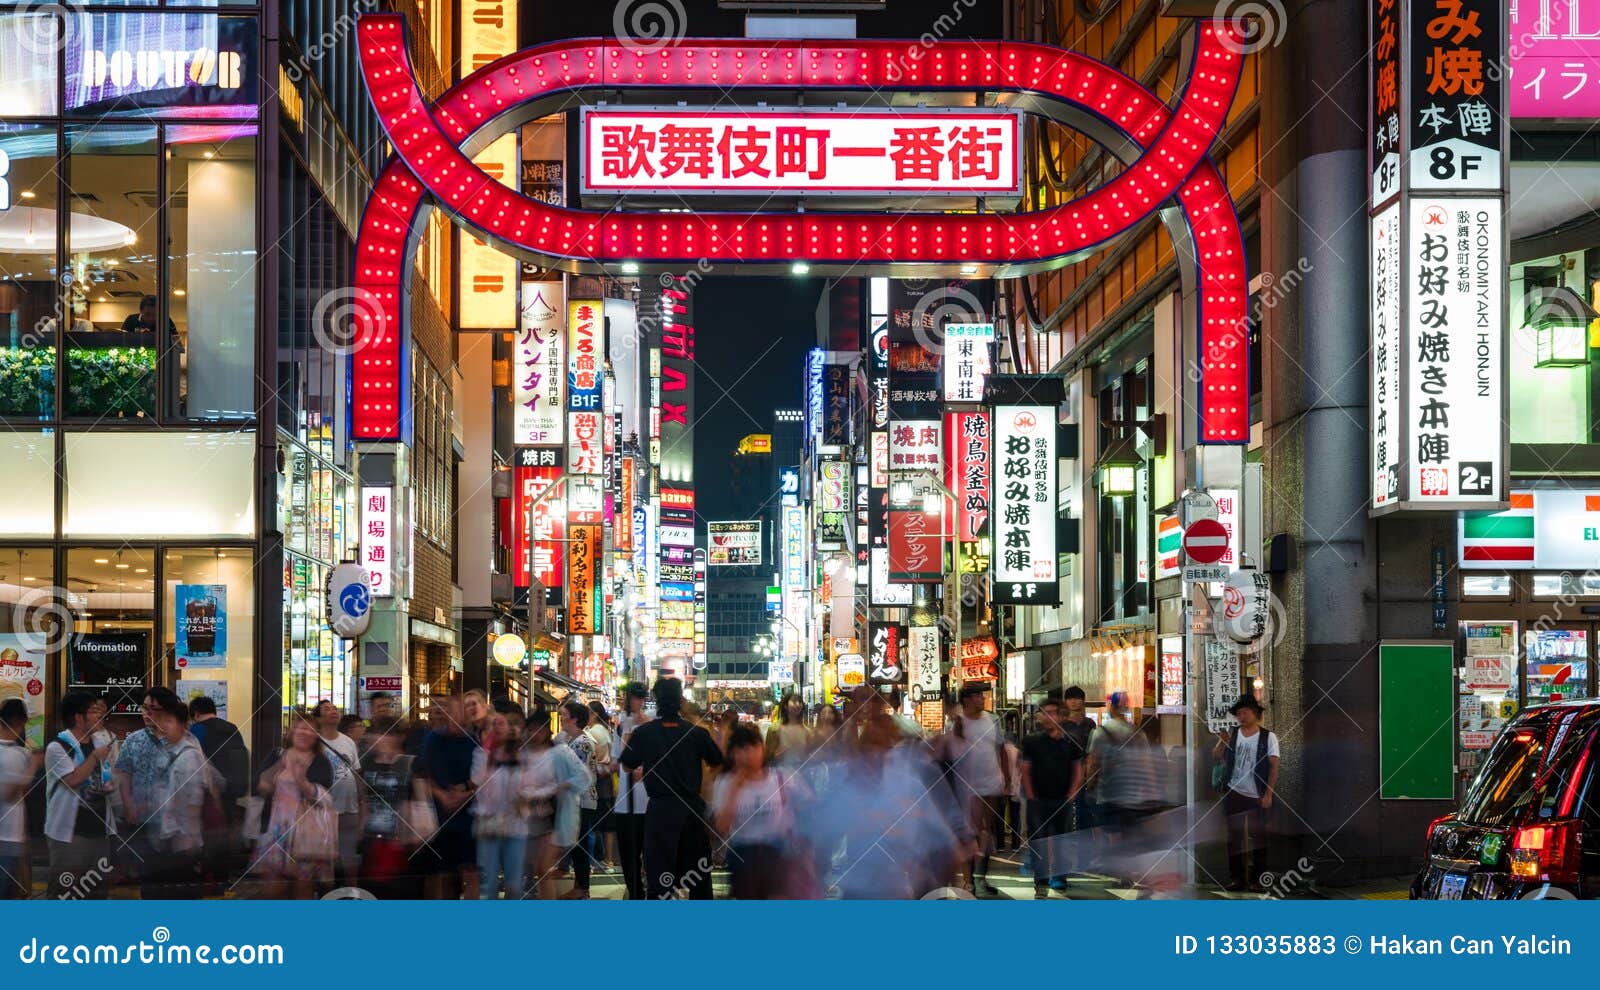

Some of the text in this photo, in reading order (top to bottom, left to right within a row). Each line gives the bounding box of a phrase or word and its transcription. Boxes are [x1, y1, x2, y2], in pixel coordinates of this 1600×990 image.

[84, 47, 241, 89] DOUTOR
[1419, 101, 1492, 137] 本陣
[602, 123, 1002, 182] 歌舞伎町一番街
[1429, 147, 1482, 180] 8F
[1379, 162, 1396, 193] 8F
[1457, 211, 1470, 293] 歌舞伎町名物
[1476, 211, 1489, 397] OKONOMIYAKI HONJIN
[575, 305, 595, 389] まぐろ商店
[1418, 233, 1450, 465] お好み焼き本陣
[958, 338, 974, 399] 東南荘
[571, 395, 600, 407] B1F
[529, 431, 548, 441] 3F
[893, 425, 939, 448] 焼肉
[522, 449, 556, 466] 焼肉
[1461, 466, 1491, 490] 2F
[577, 512, 595, 523] 4F
[368, 495, 385, 586] 劇場通り
[1186, 568, 1227, 579] 自転車を除く
[1011, 584, 1038, 599] 2F
[179, 625, 224, 633] アイスコーヒー
